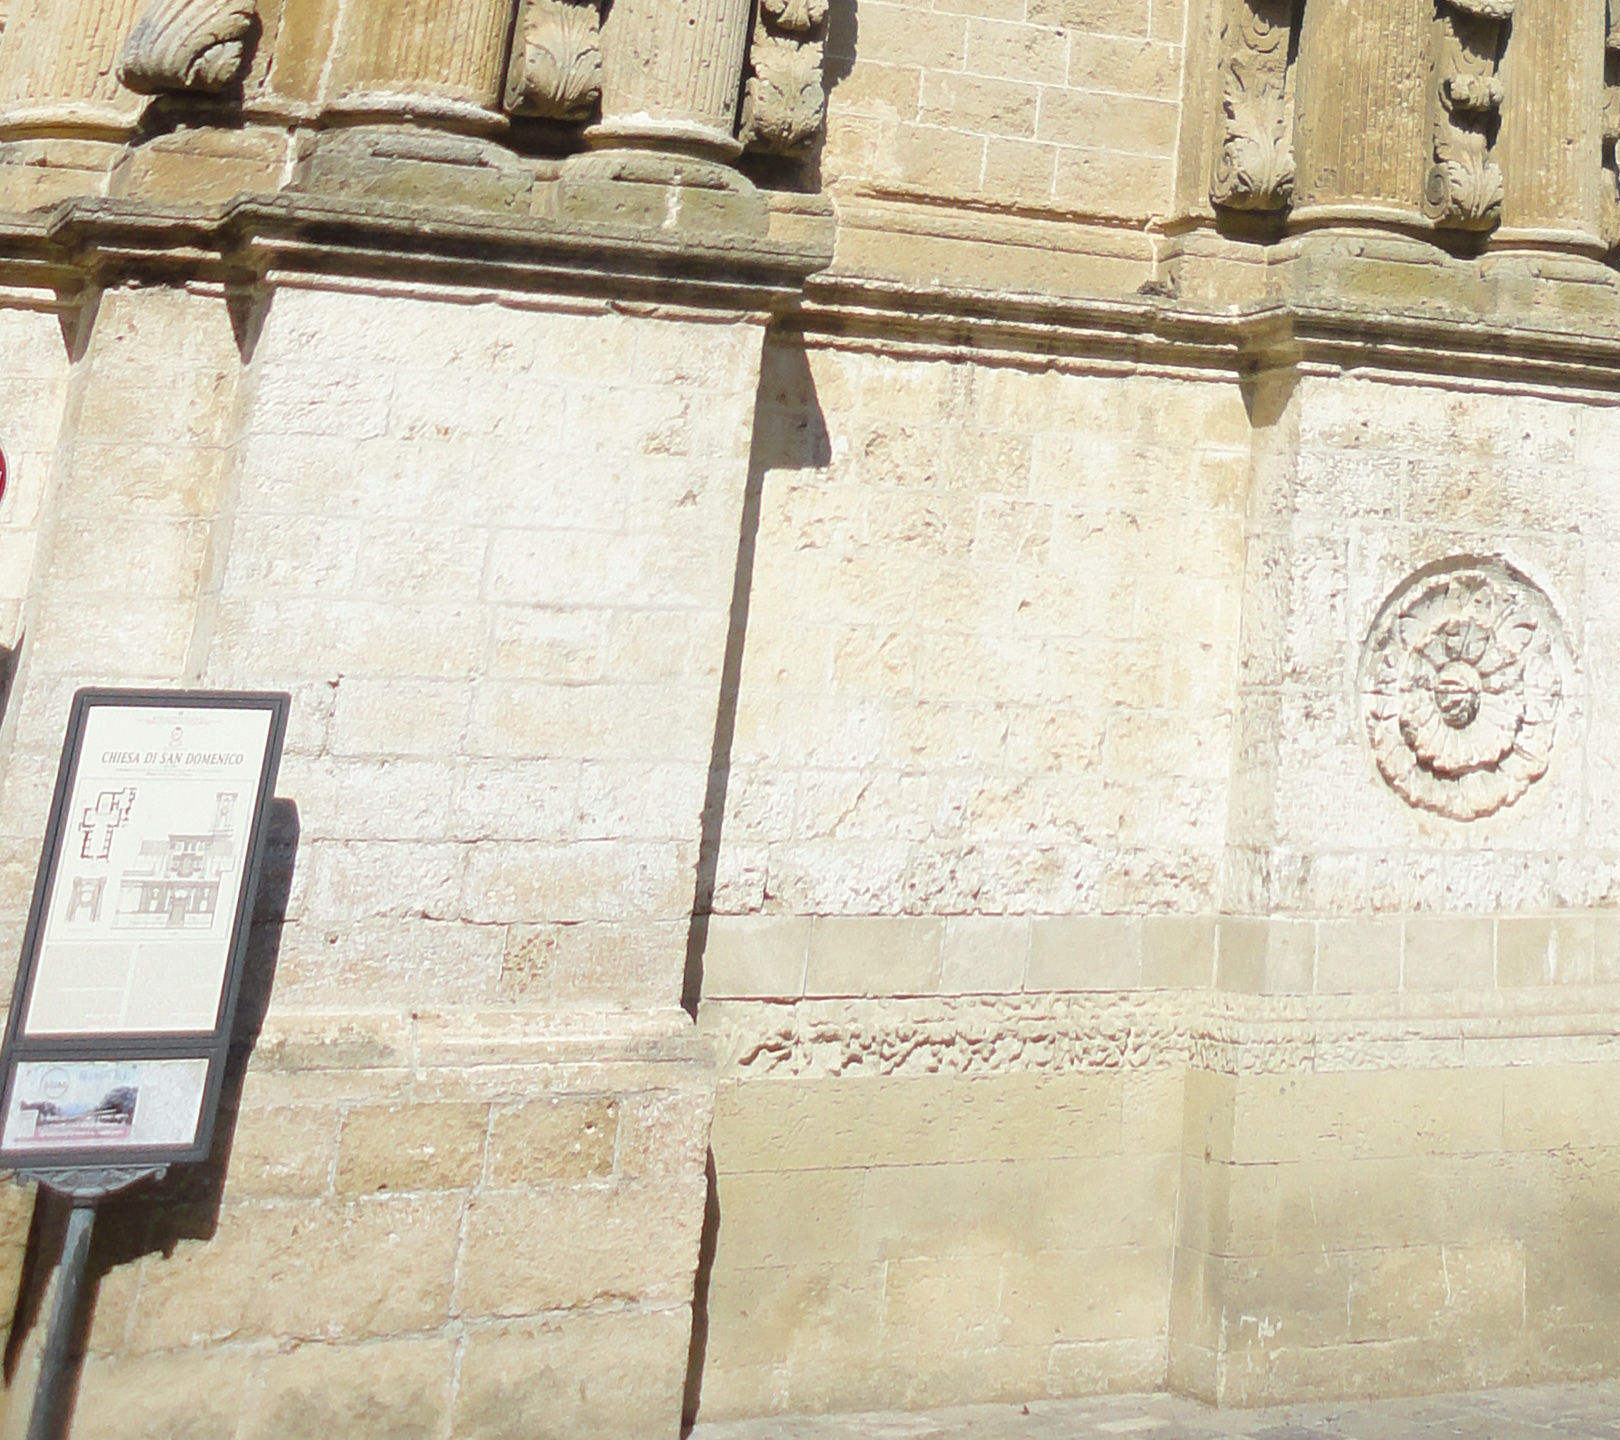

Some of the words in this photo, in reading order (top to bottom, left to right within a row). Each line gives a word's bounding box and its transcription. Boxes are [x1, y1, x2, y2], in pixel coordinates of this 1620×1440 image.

[101, 751, 140, 765] CHIESA
[144, 752, 157, 765] DI
[160, 752, 183, 765] SAN
[185, 753, 244, 766] DOMENICO
